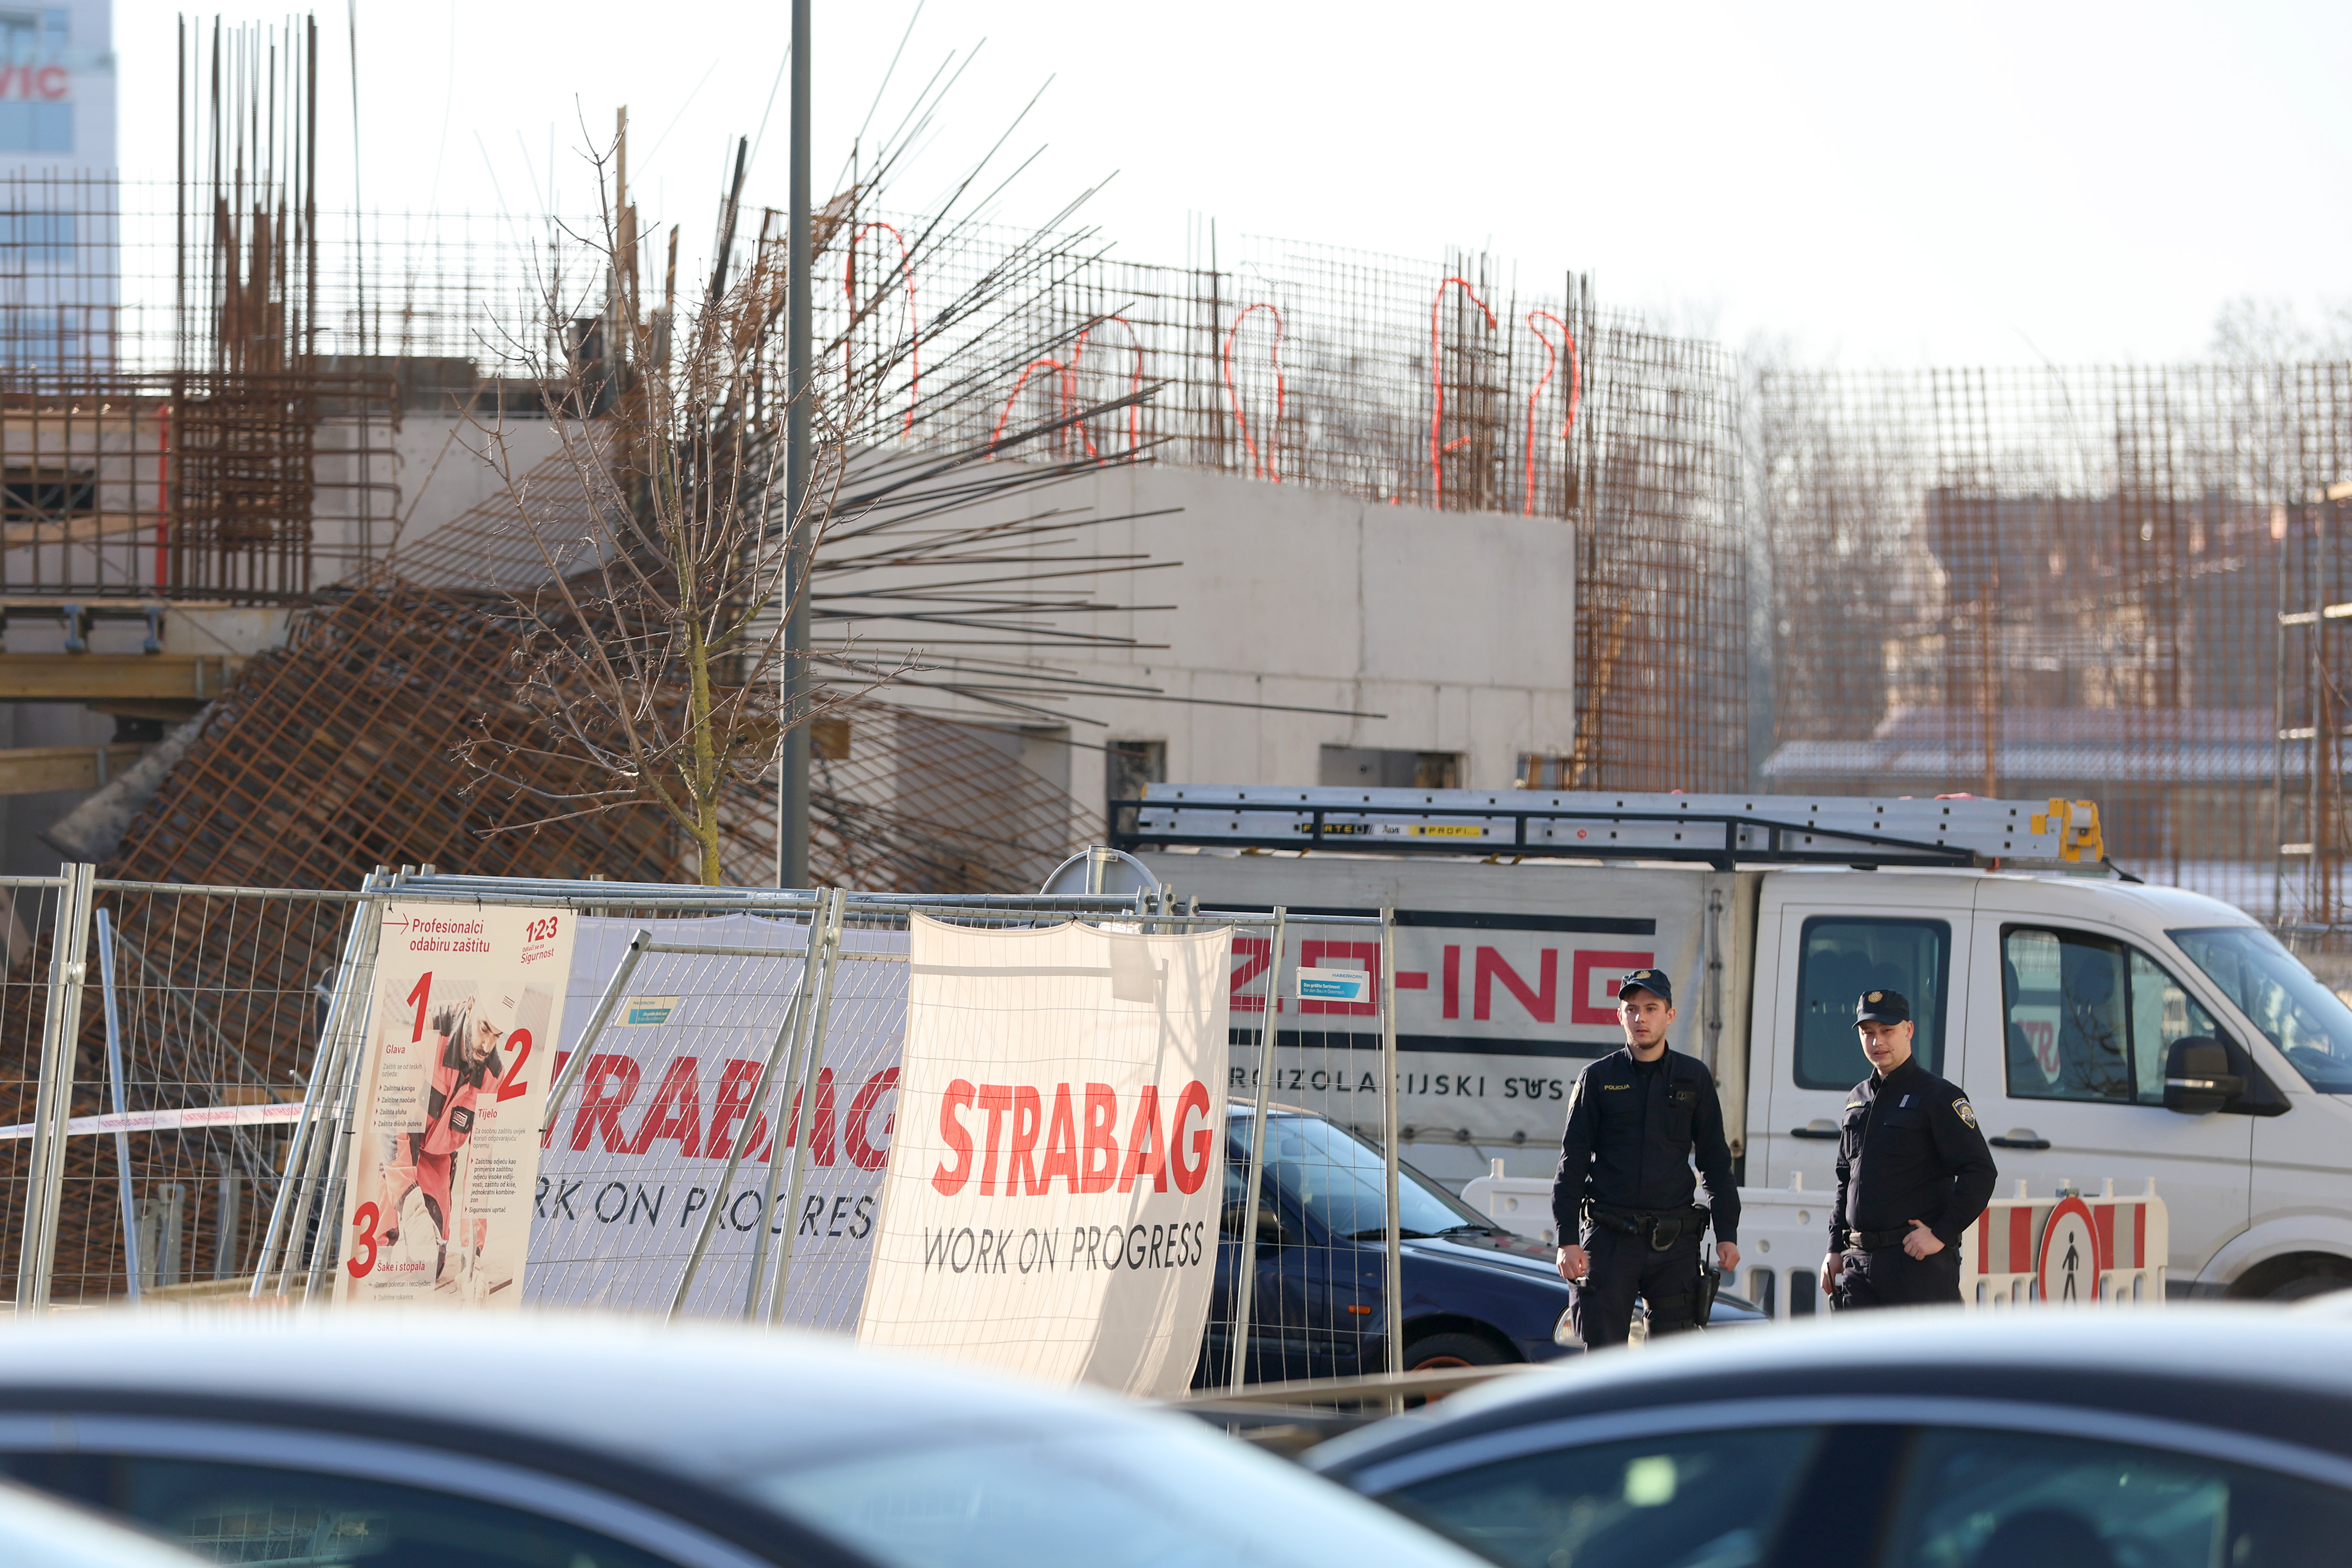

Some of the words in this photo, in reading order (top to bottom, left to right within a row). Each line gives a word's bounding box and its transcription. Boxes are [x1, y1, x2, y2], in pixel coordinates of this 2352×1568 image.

[1303, 824, 1352, 834] FRTE
[412, 918, 484, 934] Profesionalci
[410, 937, 450, 951] odabiru
[453, 938, 490, 952] zaštitu
[521, 948, 554, 964] Sigurnost
[406, 971, 433, 1044] 1
[386, 1044, 406, 1054] Glava
[496, 1028, 533, 1103] 2
[1231, 1066, 1485, 1097] RIZOLAIJSKI
[479, 1108, 497, 1120] Tijelo
[931, 1078, 1212, 1197] STRABAG
[595, 1181, 664, 1228] ON
[346, 1201, 379, 1279] 3
[925, 1226, 1013, 1274] WORK
[1019, 1226, 1058, 1274] ON
[1070, 1221, 1204, 1272] PROGRESS
[377, 1260, 394, 1272] Šake
[399, 1261, 425, 1273] stopala
